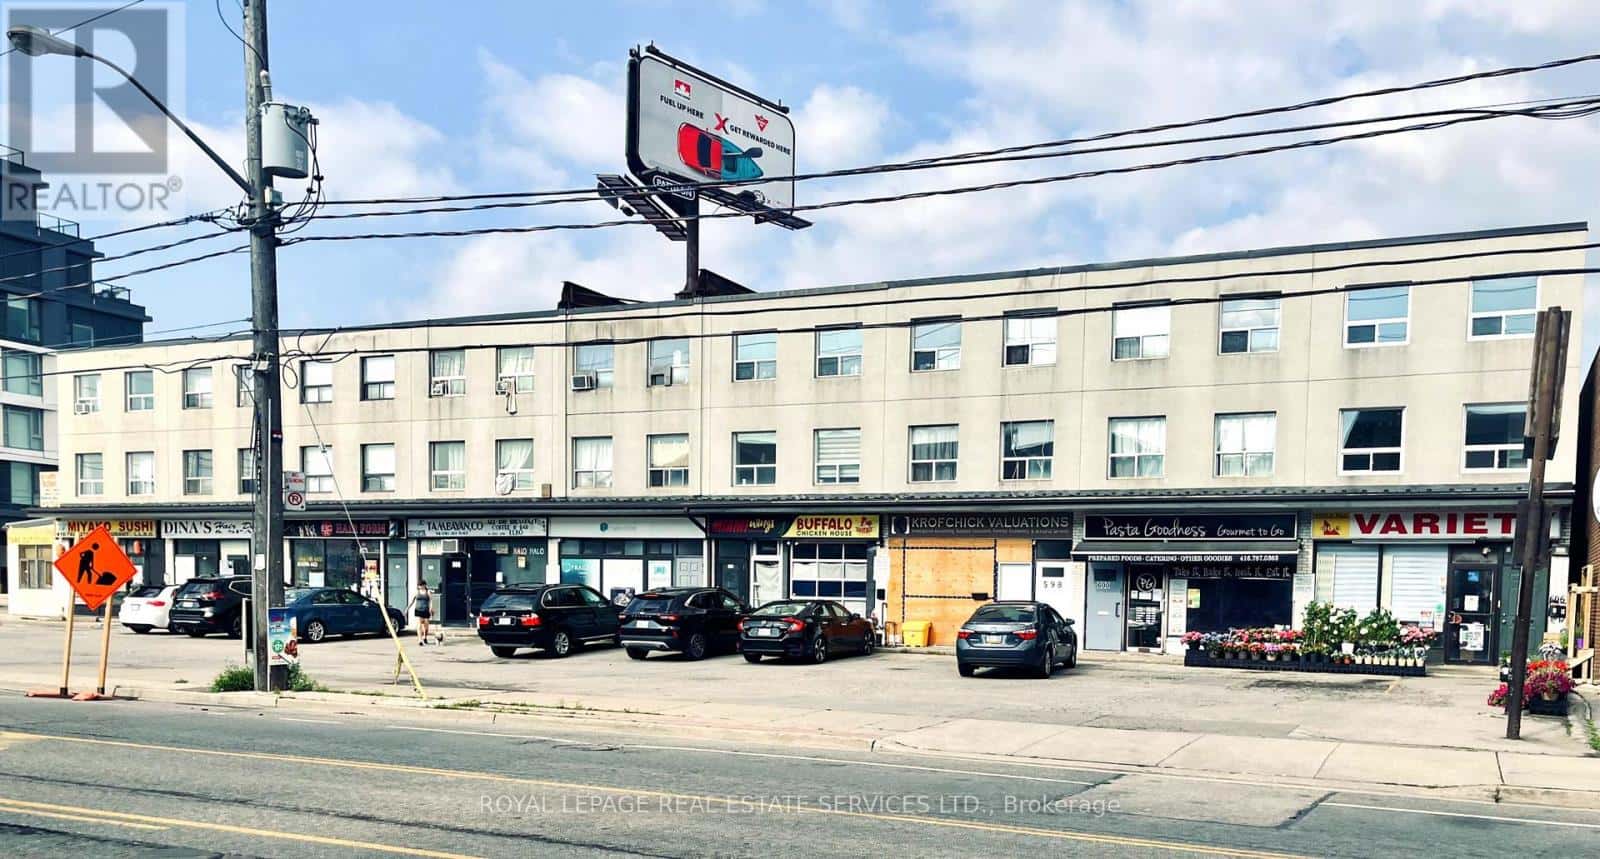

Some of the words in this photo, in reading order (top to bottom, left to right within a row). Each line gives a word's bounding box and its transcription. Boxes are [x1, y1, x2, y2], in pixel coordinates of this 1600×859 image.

[660, 94, 676, 108] FUEL
[677, 102, 687, 111] UP
[687, 106, 704, 119] HERE
[730, 125, 742, 135] GET
[742, 130, 776, 148] REWARDED
[775, 143, 791, 156] HERE
[119, 520, 154, 533] SUSHI
[163, 520, 212, 534] DINA'S
[797, 517, 852, 530] BUFFALO
[912, 516, 984, 528] KROFCHICK
[988, 516, 1070, 528] VALUATIONS
[1103, 517, 1141, 536] Pasta
[1144, 518, 1207, 537] Goodness
[1217, 524, 1257, 537] Gourmet
[1259, 526, 1269, 537] to
[1271, 524, 1286, 537] Go
[1354, 512, 1517, 535] VARIET
[1043, 580, 1063, 589] 598
